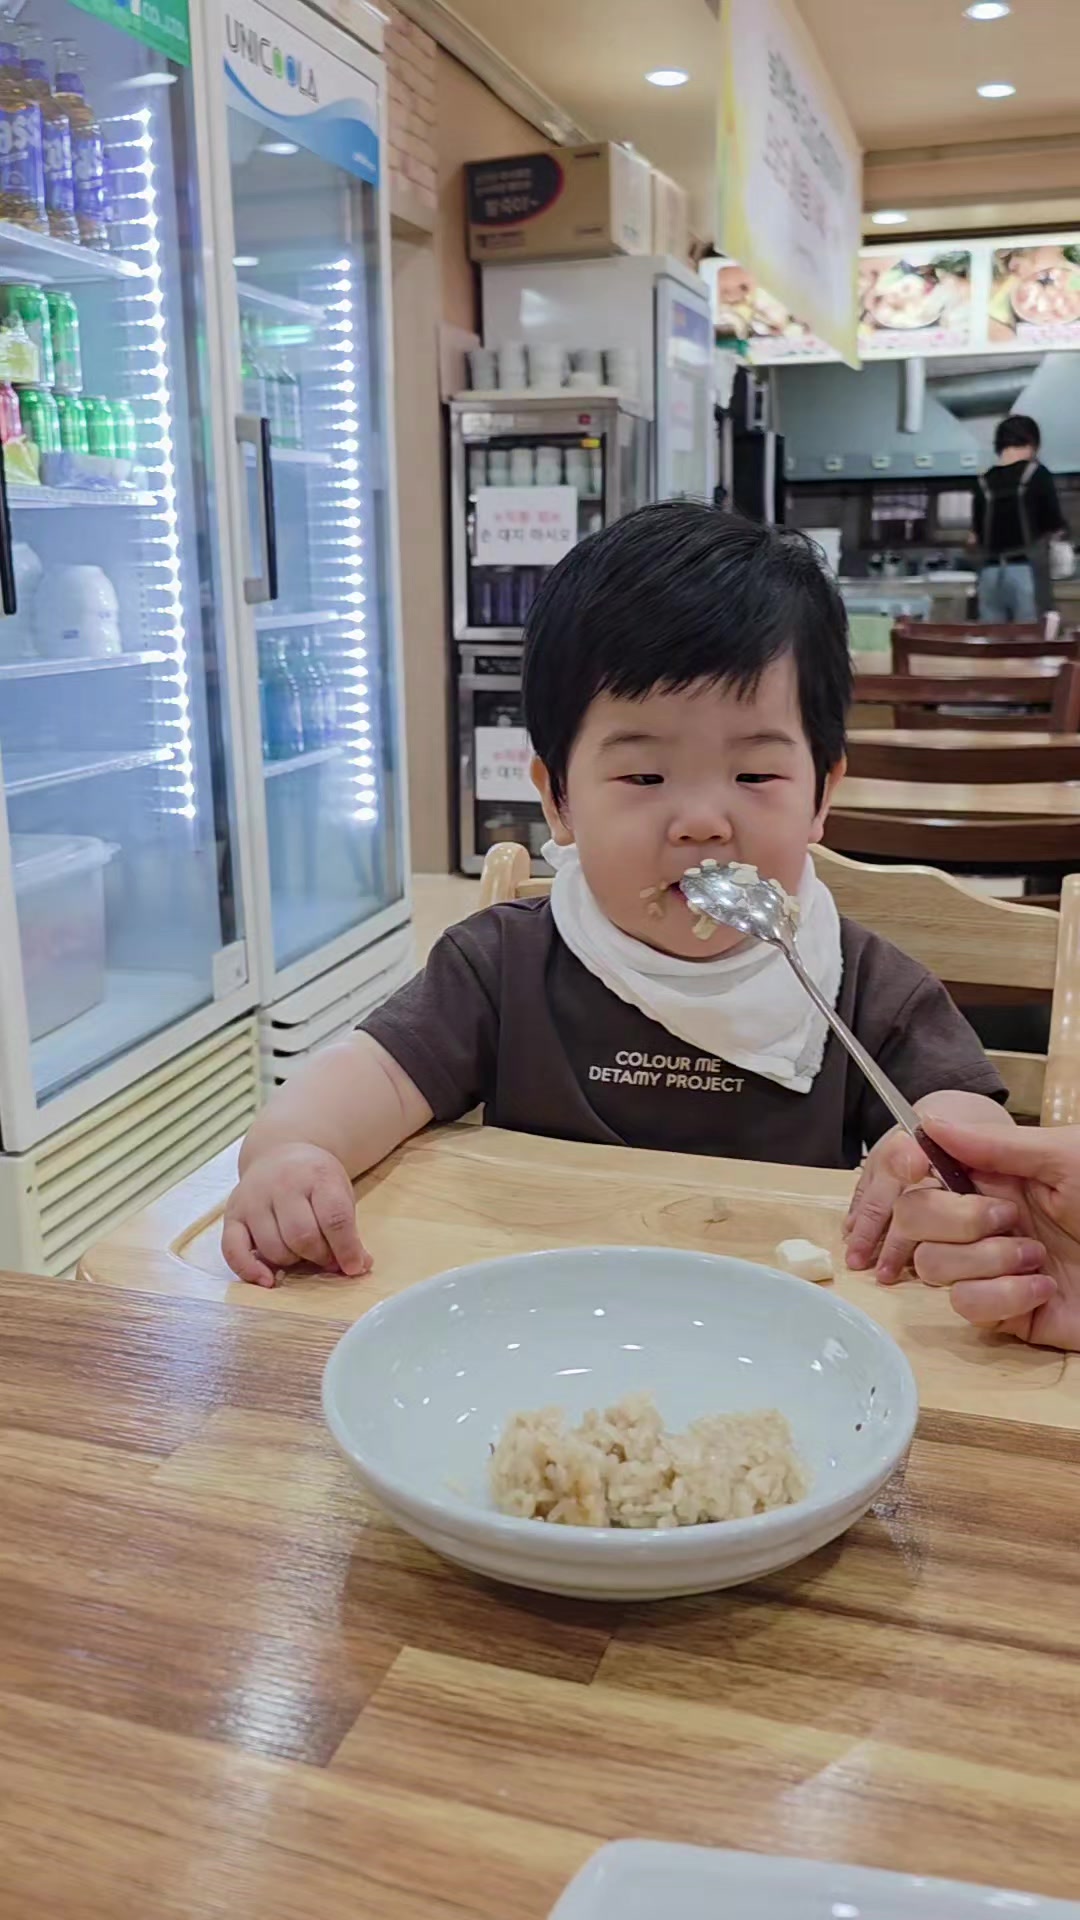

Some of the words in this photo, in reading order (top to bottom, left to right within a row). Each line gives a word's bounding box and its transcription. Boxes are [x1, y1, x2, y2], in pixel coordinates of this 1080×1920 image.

[224, 13, 319, 103] UNICOOLA
[615, 1050, 690, 1070] COLOUR
[694, 1058, 721, 1073] ME
[588, 1065, 661, 1087] DETAMY
[665, 1073, 745, 1092] PROJECT
